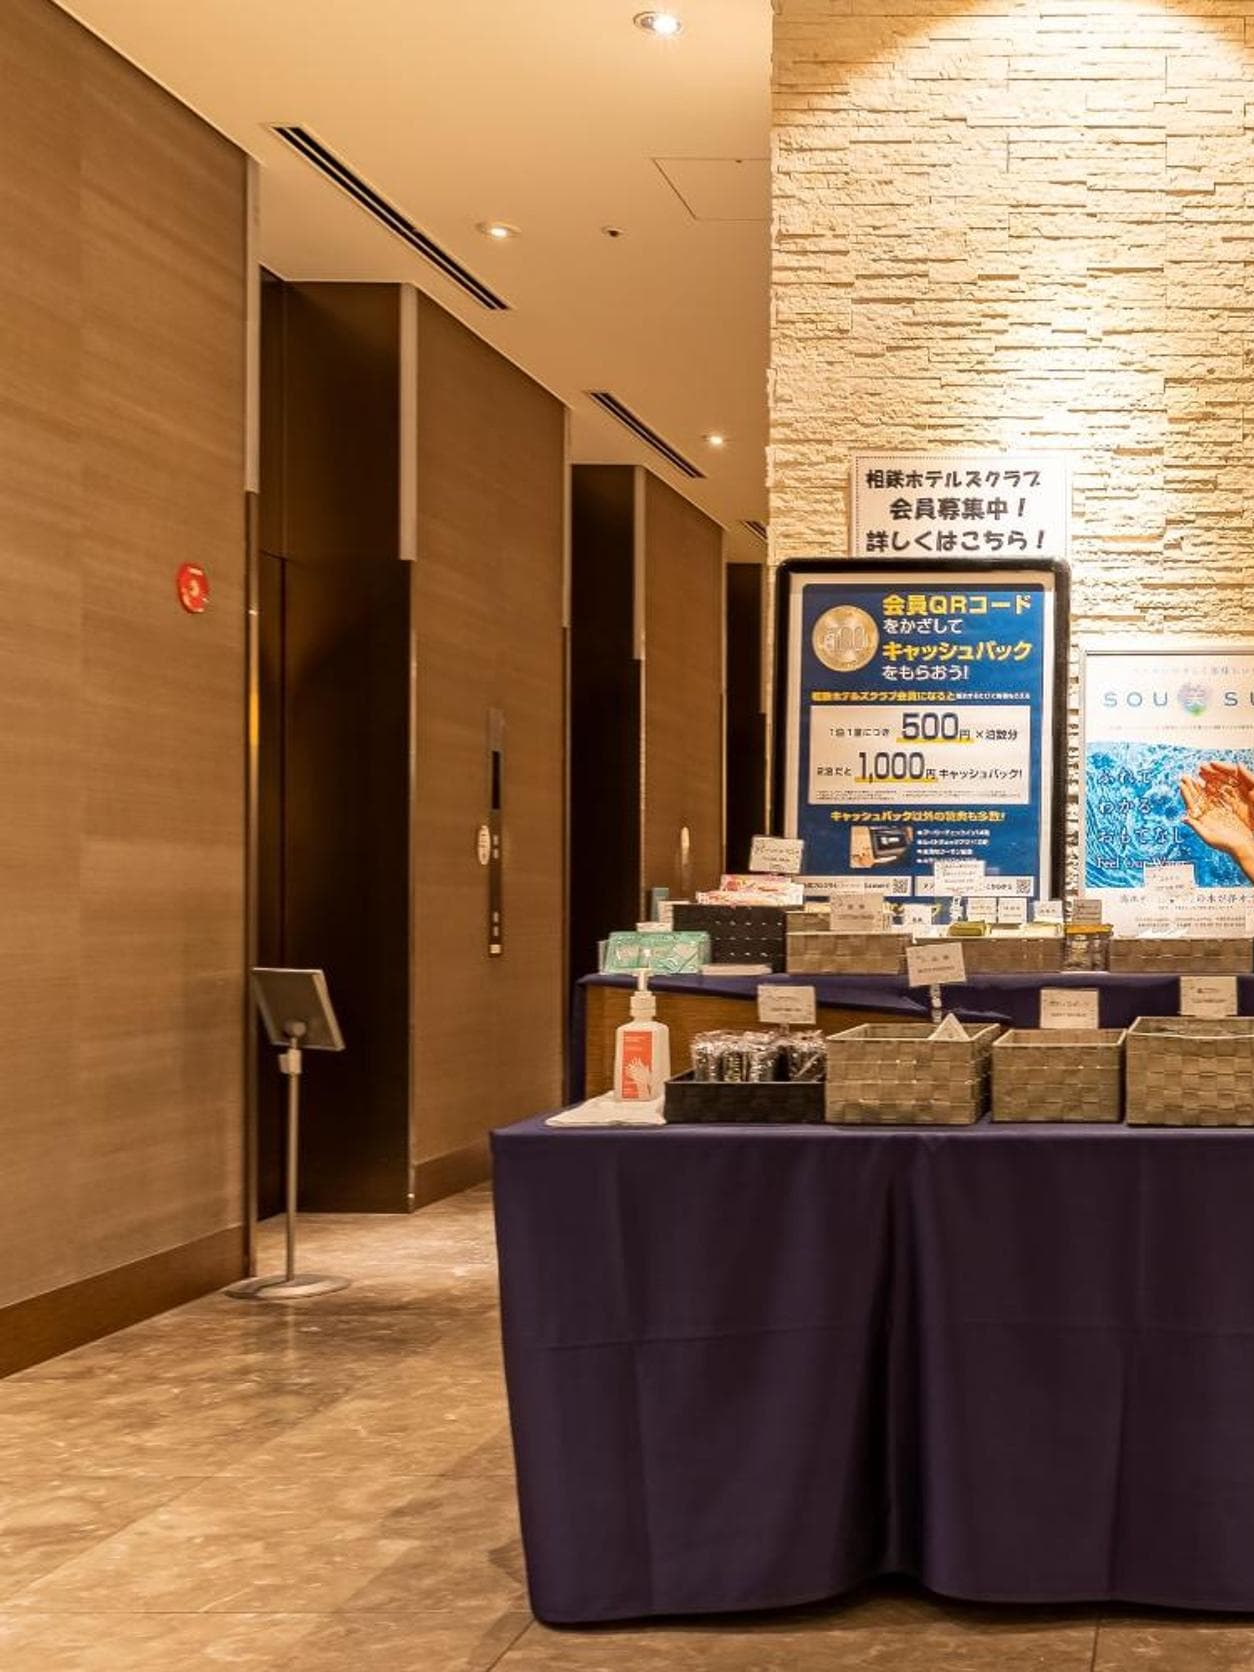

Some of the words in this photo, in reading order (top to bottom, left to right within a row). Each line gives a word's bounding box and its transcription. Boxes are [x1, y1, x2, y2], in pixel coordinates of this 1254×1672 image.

[882, 594, 1032, 616] 会員QRコード
[883, 618, 963, 634] をかざして
[882, 642, 1032, 662] キャッシュバック
[1103, 691, 1169, 707] SOU
